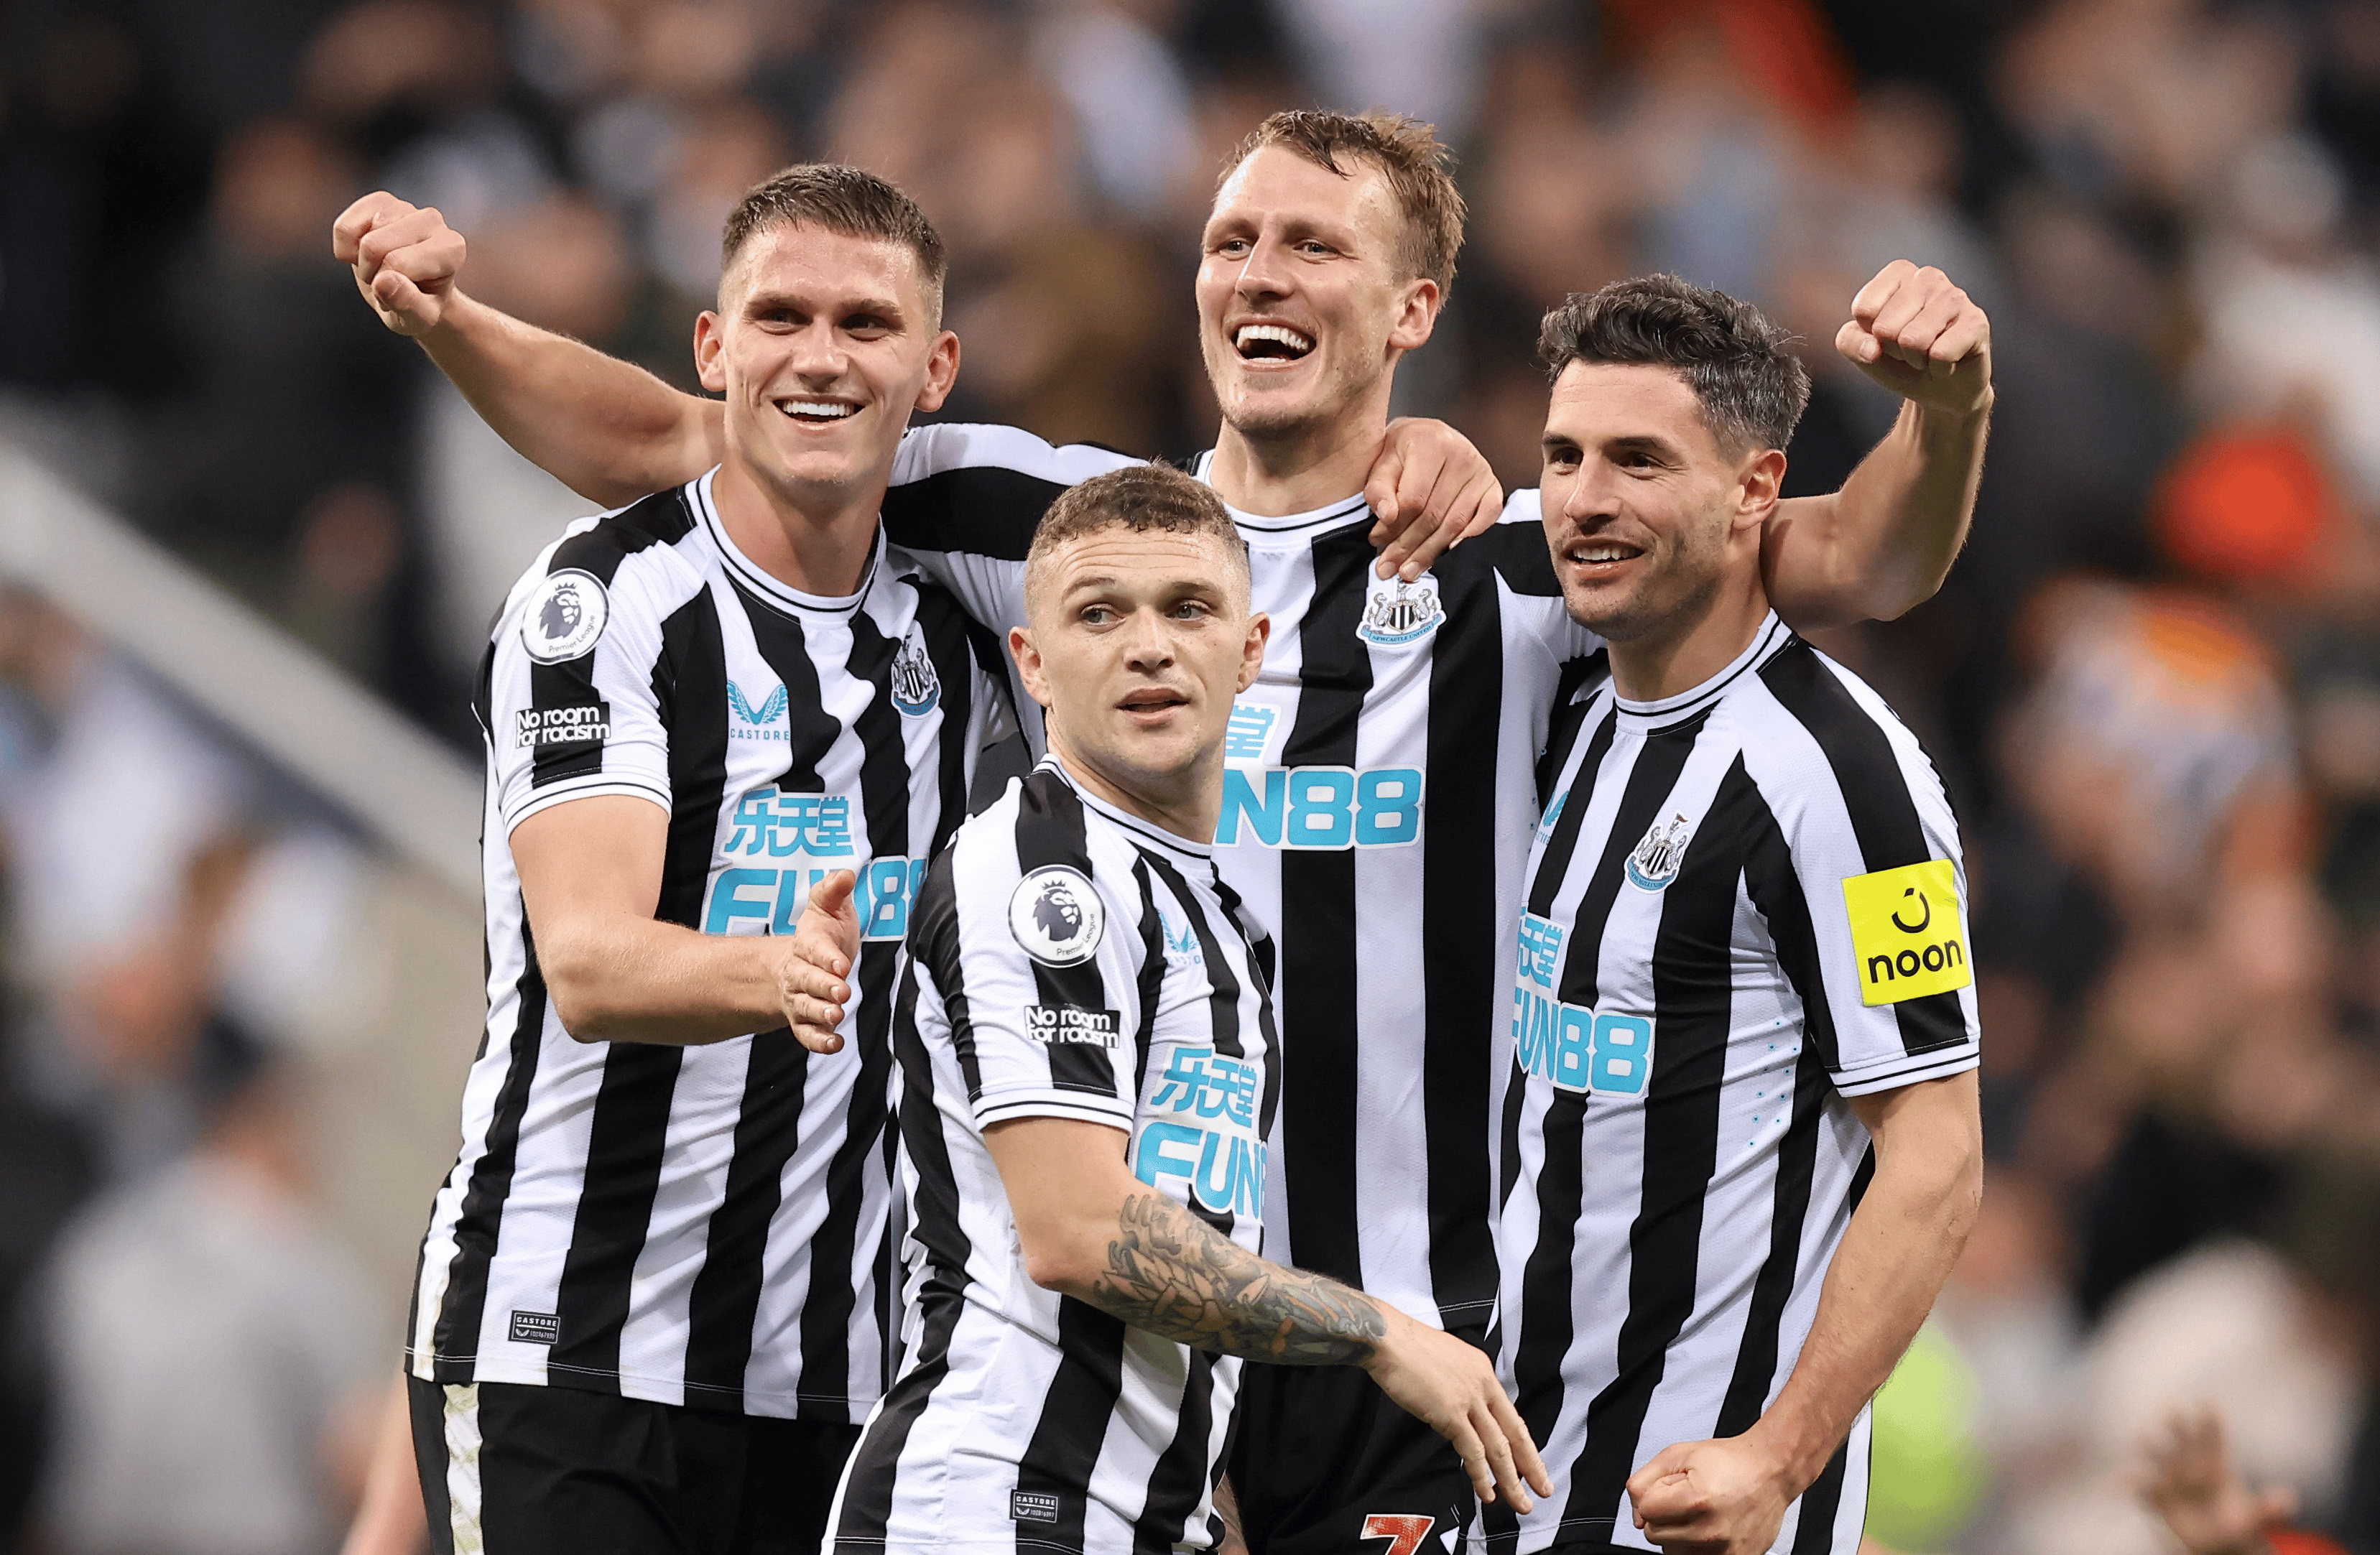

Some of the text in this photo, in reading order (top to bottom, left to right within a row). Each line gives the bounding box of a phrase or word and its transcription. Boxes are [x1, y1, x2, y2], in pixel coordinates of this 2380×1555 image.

[548, 615, 596, 653] Premier League
[517, 707, 600, 729] No room
[517, 723, 611, 748] for racism
[730, 728, 790, 741] CASTORE
[723, 787, 854, 857] 乐天堂
[705, 859, 928, 937] FU8
[1517, 906, 1563, 989] 天堂
[1868, 939, 1963, 984] noon
[1024, 1006, 1111, 1030] No room
[1027, 1023, 1057, 1042] for
[1512, 986, 1651, 1094] UN88
[1150, 1047, 1257, 1128] 乐天堂
[1136, 1122, 1267, 1220] FUN
[517, 1317, 557, 1327] CASTORE
[1016, 1495, 1055, 1506] CASTORE
